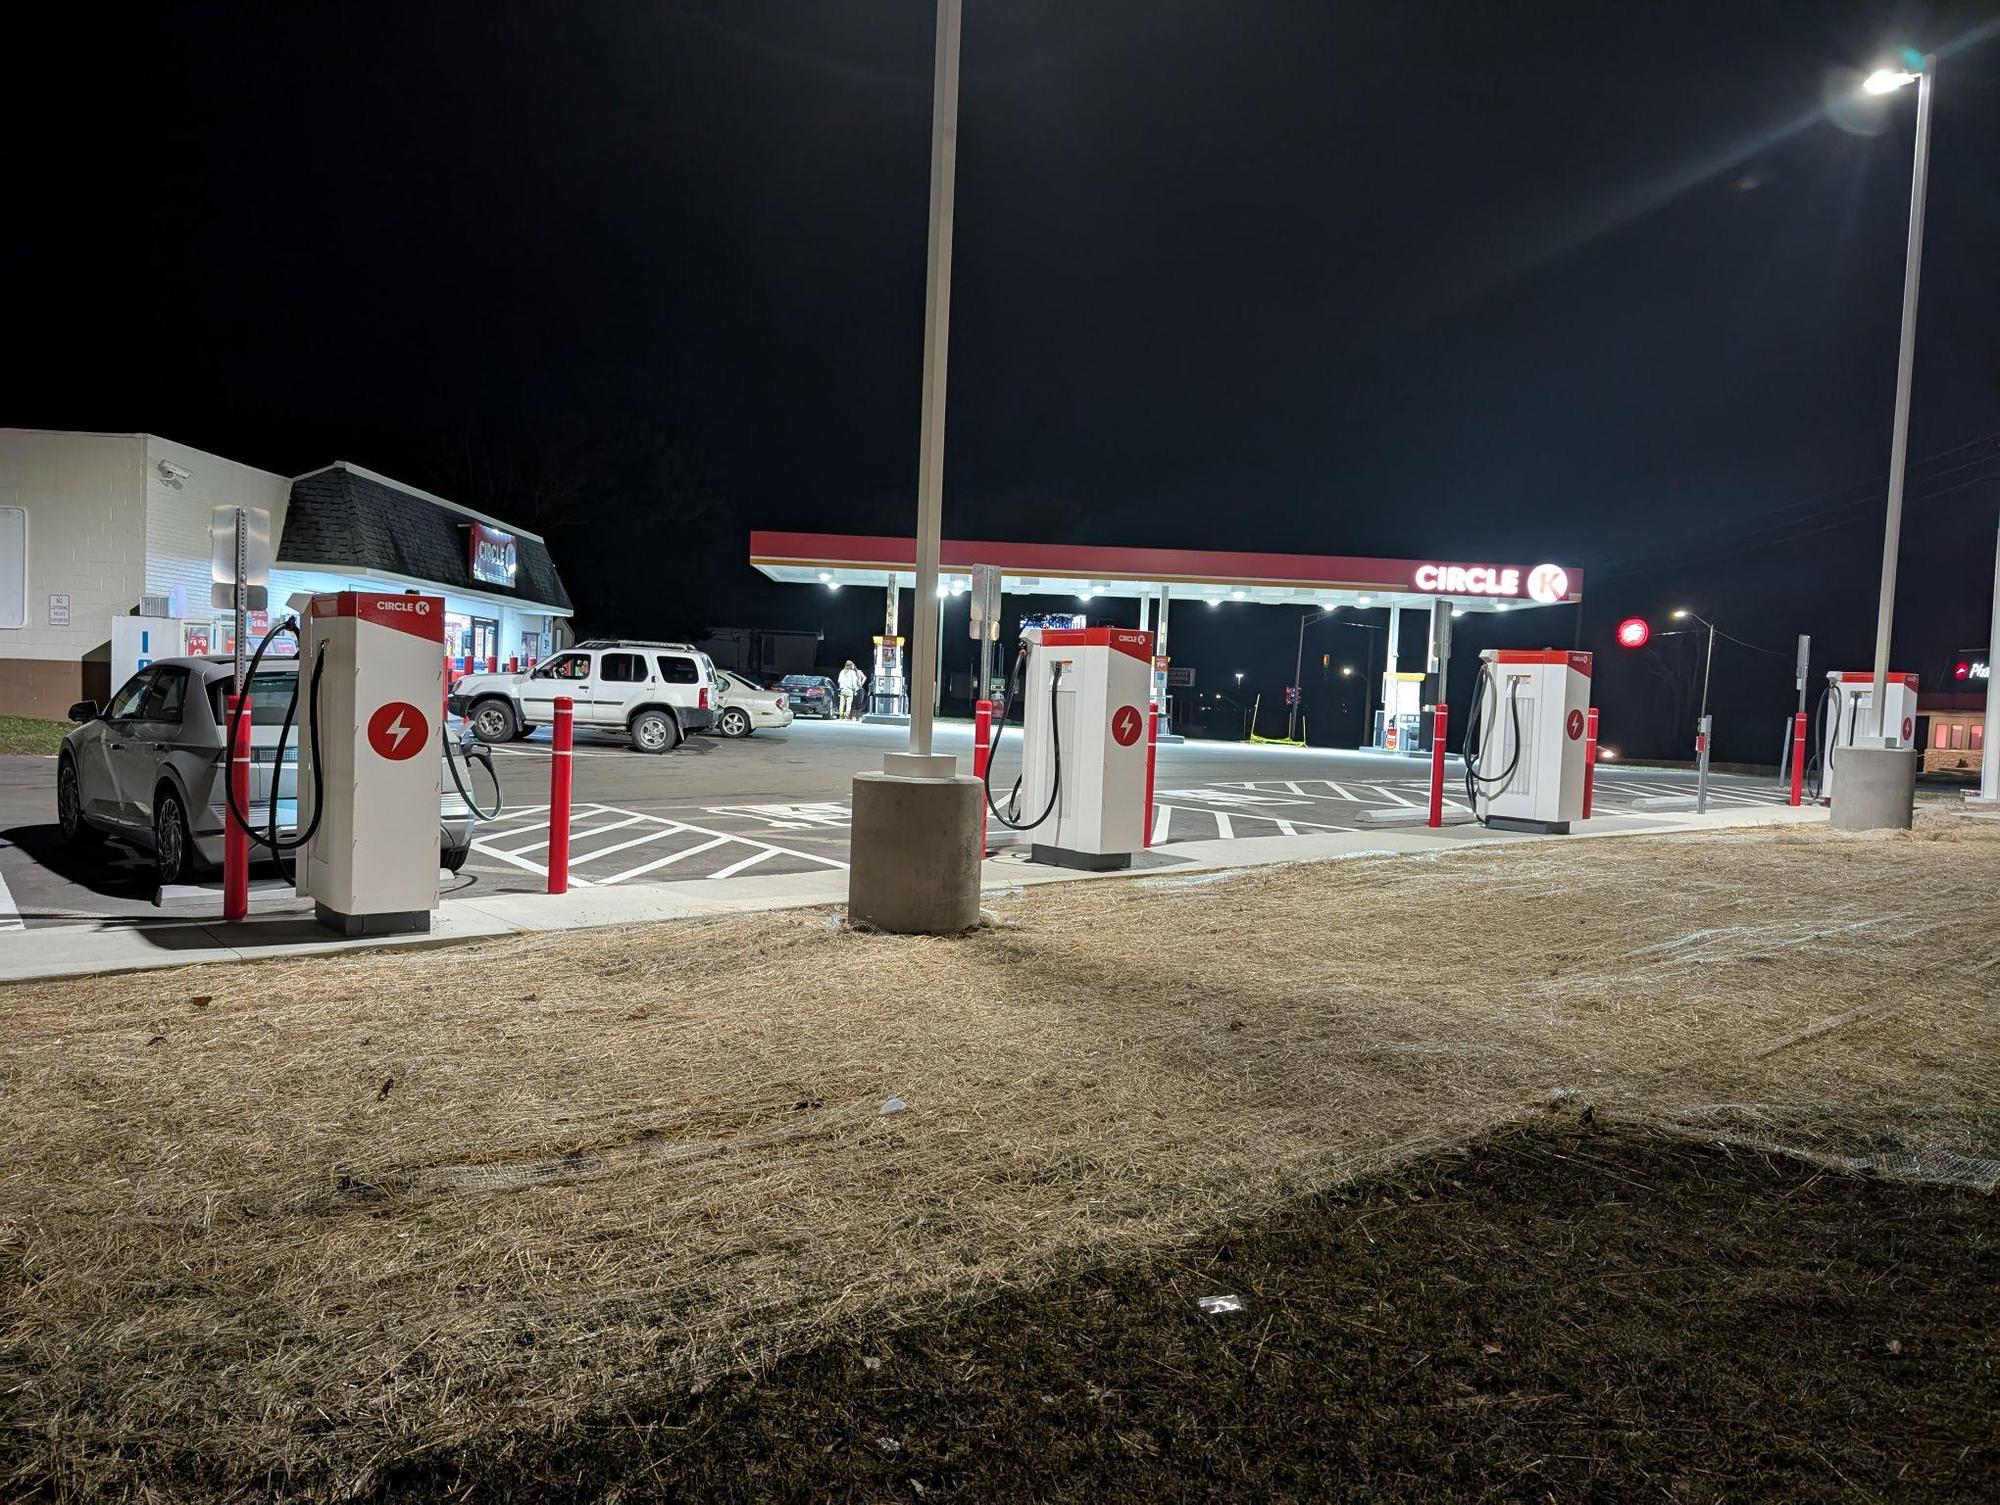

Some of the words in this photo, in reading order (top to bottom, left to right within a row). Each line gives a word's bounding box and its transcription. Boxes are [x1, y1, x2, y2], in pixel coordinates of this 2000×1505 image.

[479, 541, 505, 566] CIRCLE
[1415, 565, 1520, 595] CIRCLE
[1531, 567, 1565, 602] K
[377, 601, 413, 612] CIRCLE
[416, 601, 430, 615] K
[1119, 635, 1137, 643] CIRCLE
